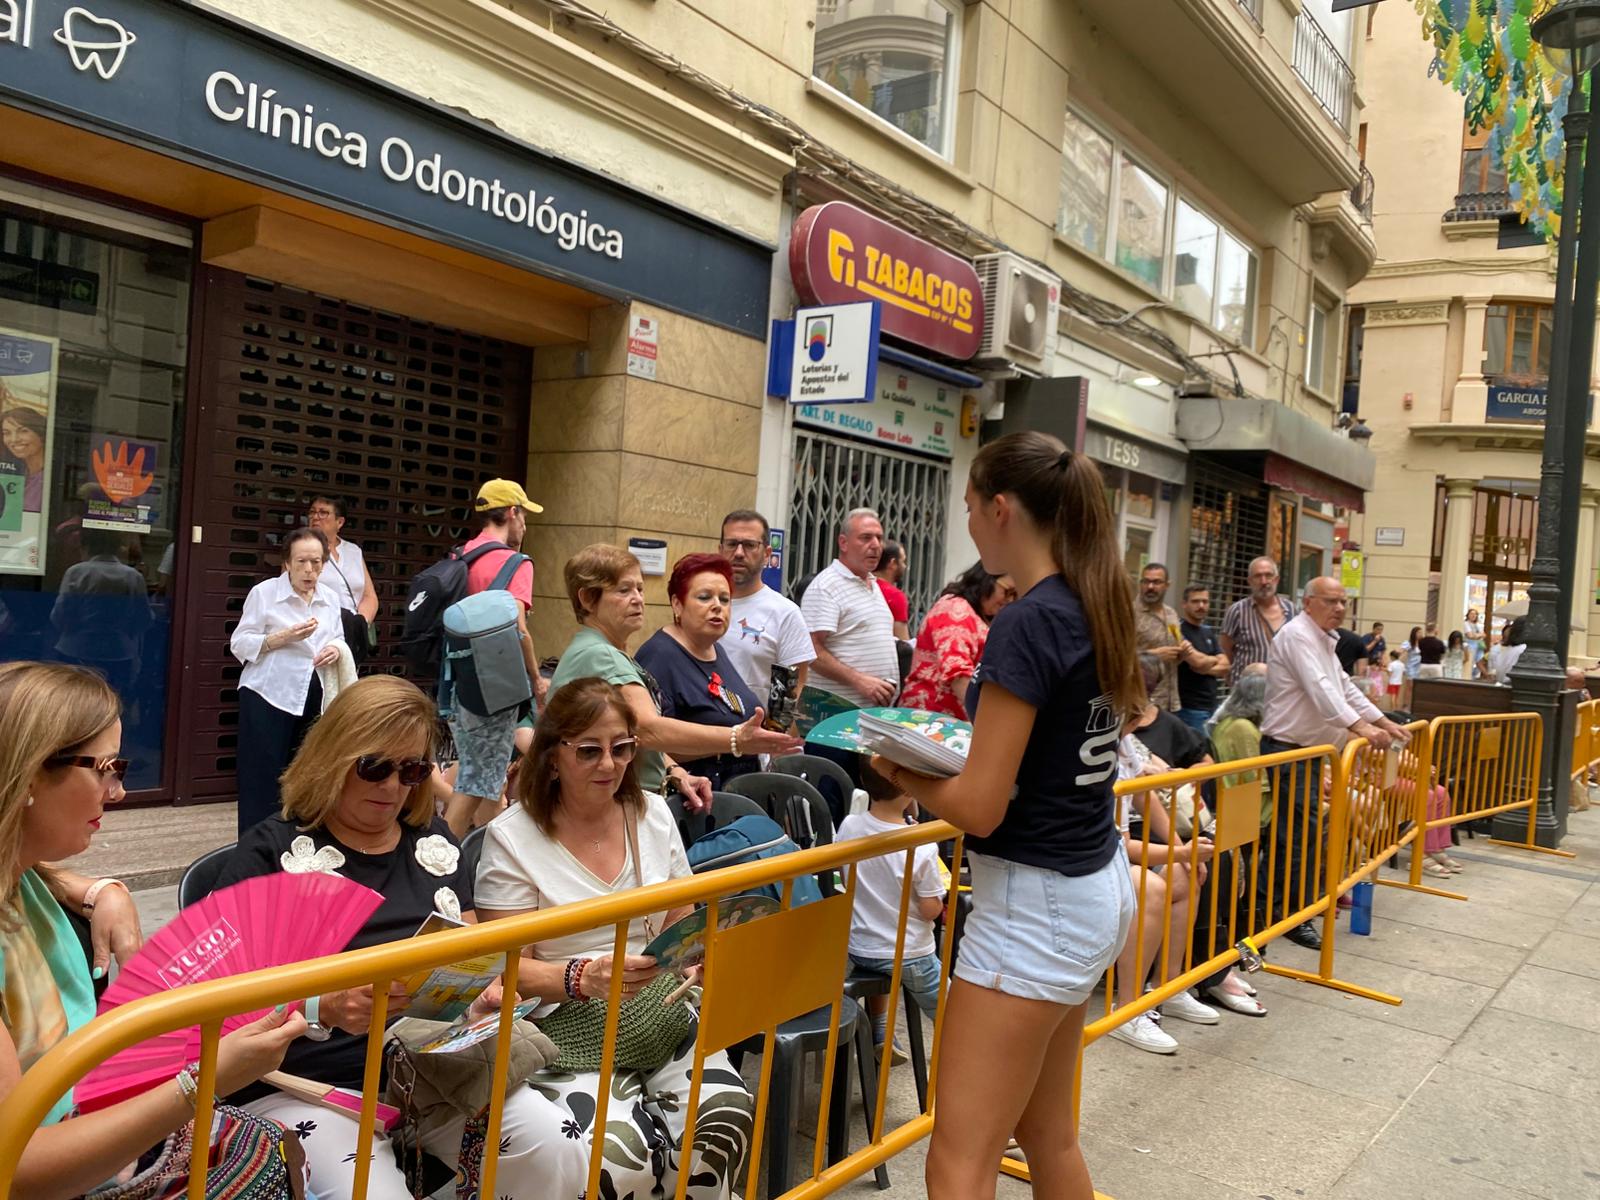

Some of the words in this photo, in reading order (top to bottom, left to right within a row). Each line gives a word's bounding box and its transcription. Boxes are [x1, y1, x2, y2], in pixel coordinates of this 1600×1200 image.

[205, 71, 366, 168] Clínica
[380, 137, 623, 259] Odontológica
[865, 245, 973, 320] TABACOS
[800, 385, 826, 395] Estado
[801, 374, 836, 386] Apuestas
[837, 372, 850, 382] del
[1497, 391, 1540, 405] GARCIA
[823, 410, 836, 423] DE
[839, 413, 873, 433] REGALO
[1522, 407, 1547, 416] ABOGA
[1105, 435, 1140, 468] TESS
[167, 928, 226, 977] YUGO
